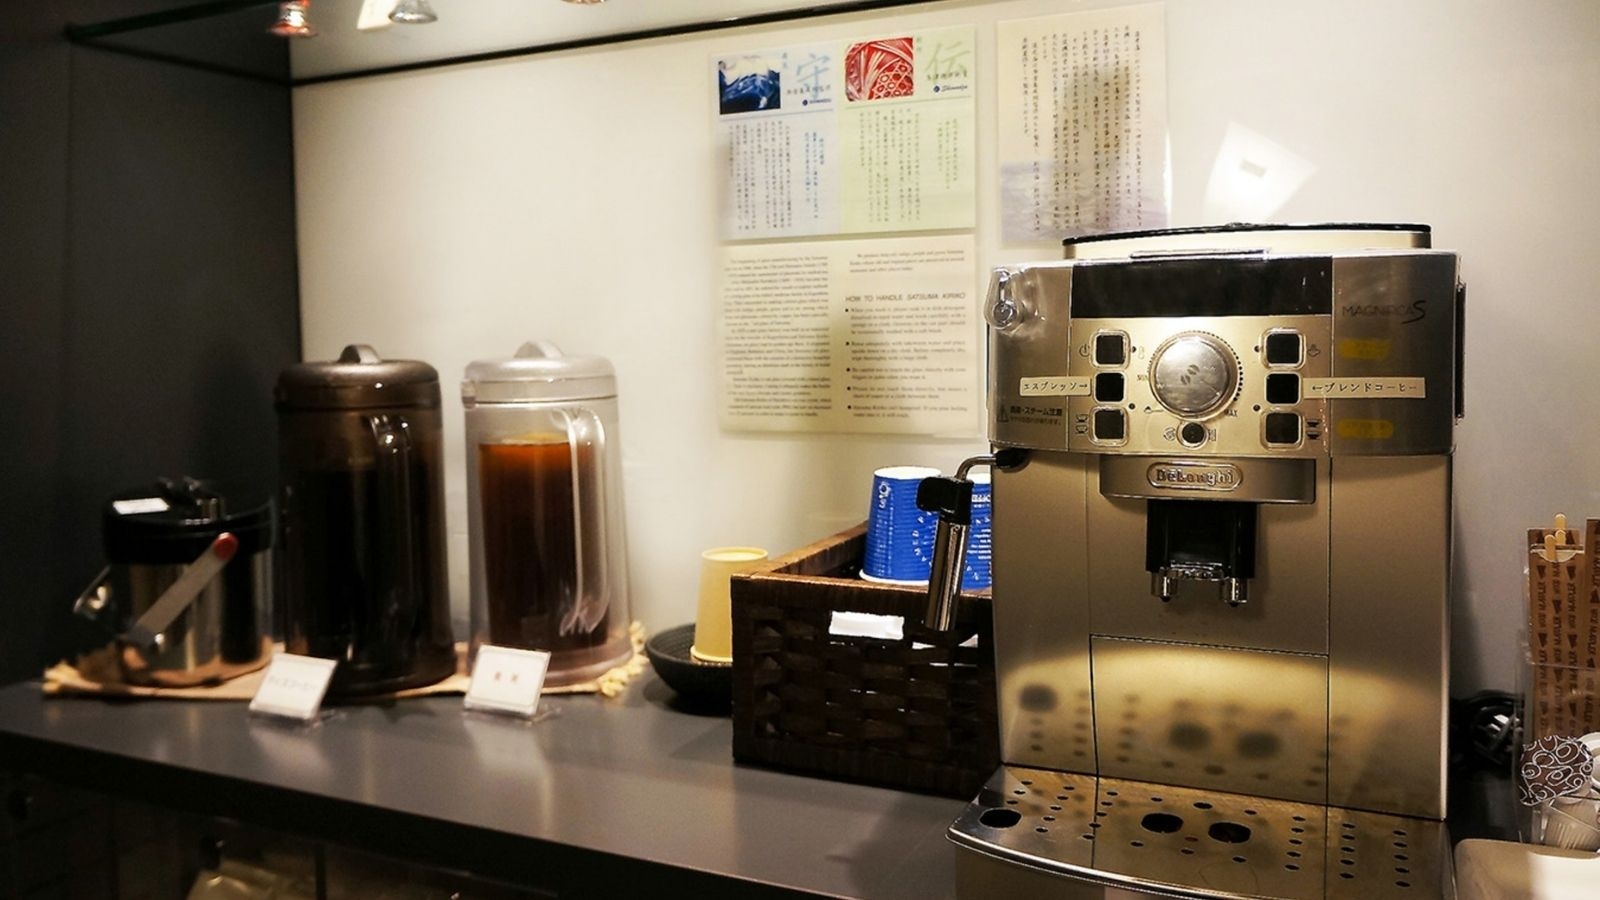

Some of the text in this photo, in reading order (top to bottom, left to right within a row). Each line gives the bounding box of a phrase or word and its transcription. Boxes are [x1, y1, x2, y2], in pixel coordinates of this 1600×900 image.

[1324, 381, 1417, 393] ブレンドコーヒー
